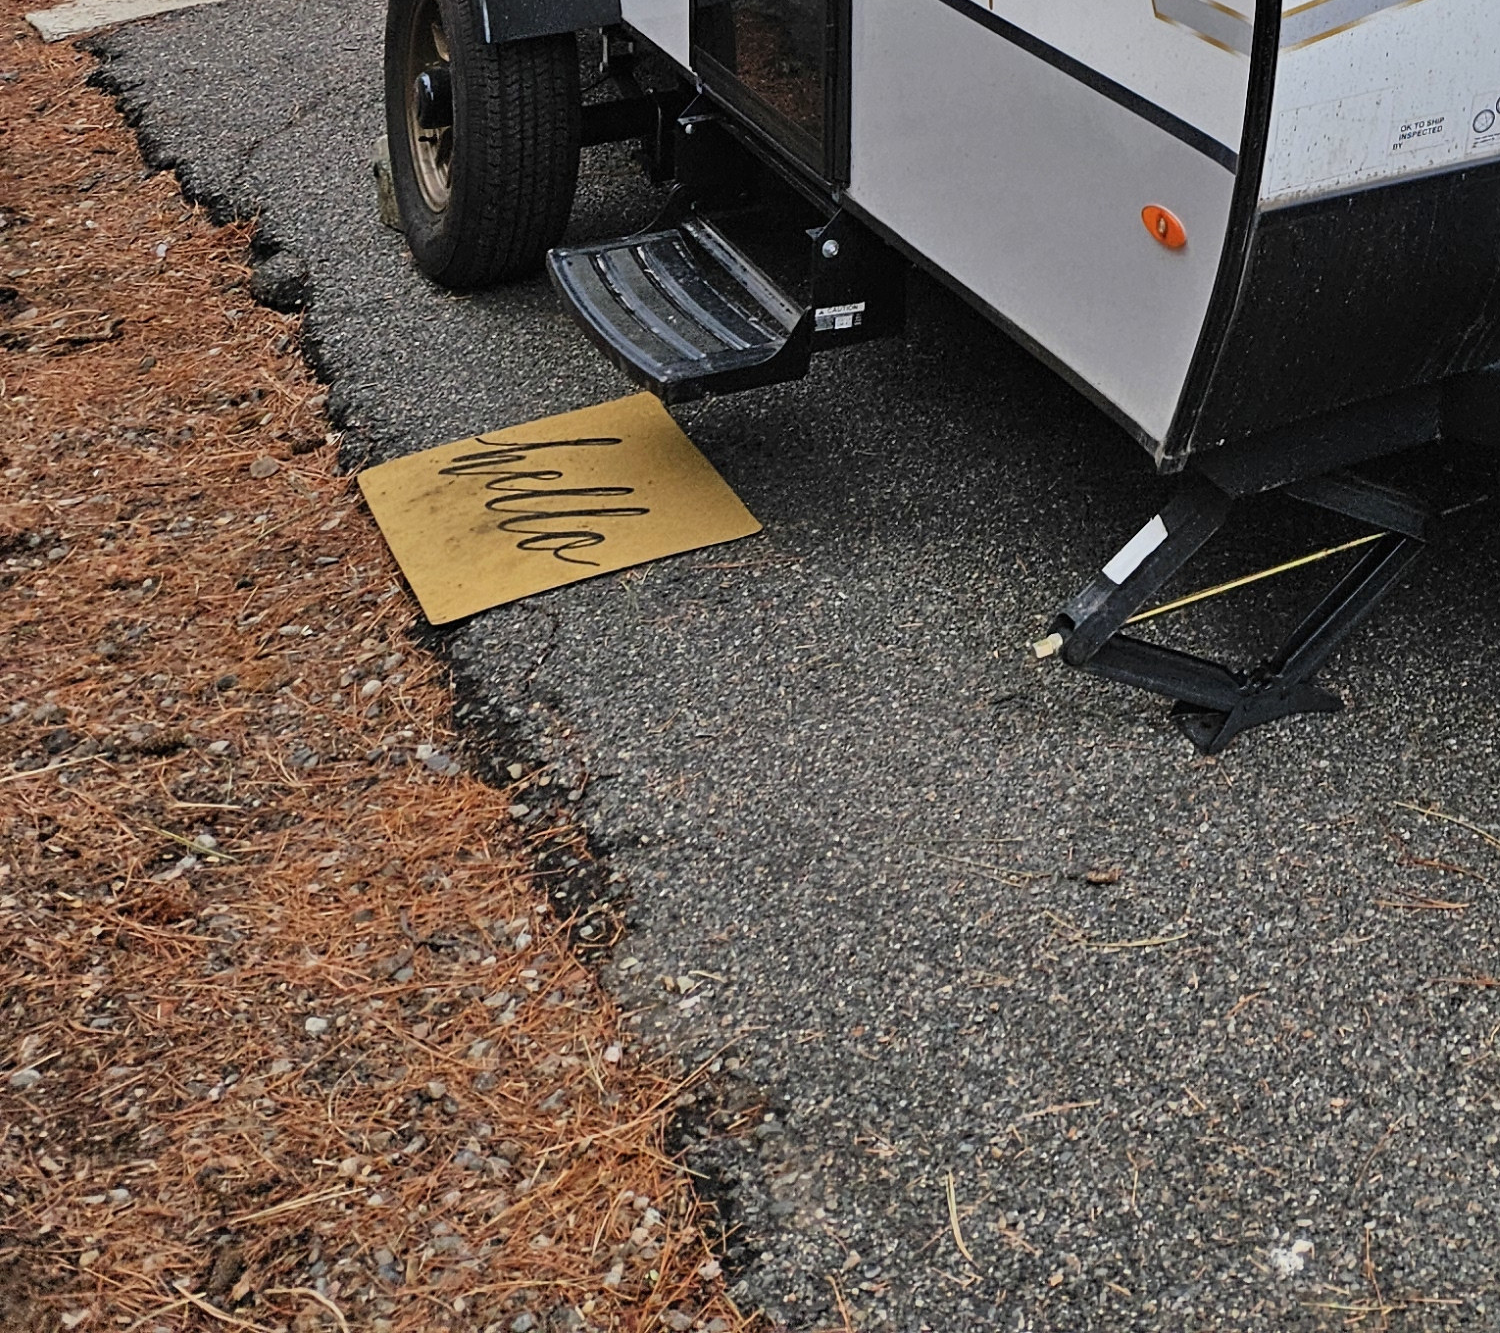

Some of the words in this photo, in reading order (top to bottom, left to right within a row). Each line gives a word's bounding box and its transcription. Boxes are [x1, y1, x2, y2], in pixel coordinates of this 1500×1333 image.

[1414, 121, 1425, 129] TO
[1427, 117, 1444, 127] SHIP
[1399, 125, 1443, 141] INSPECTED
